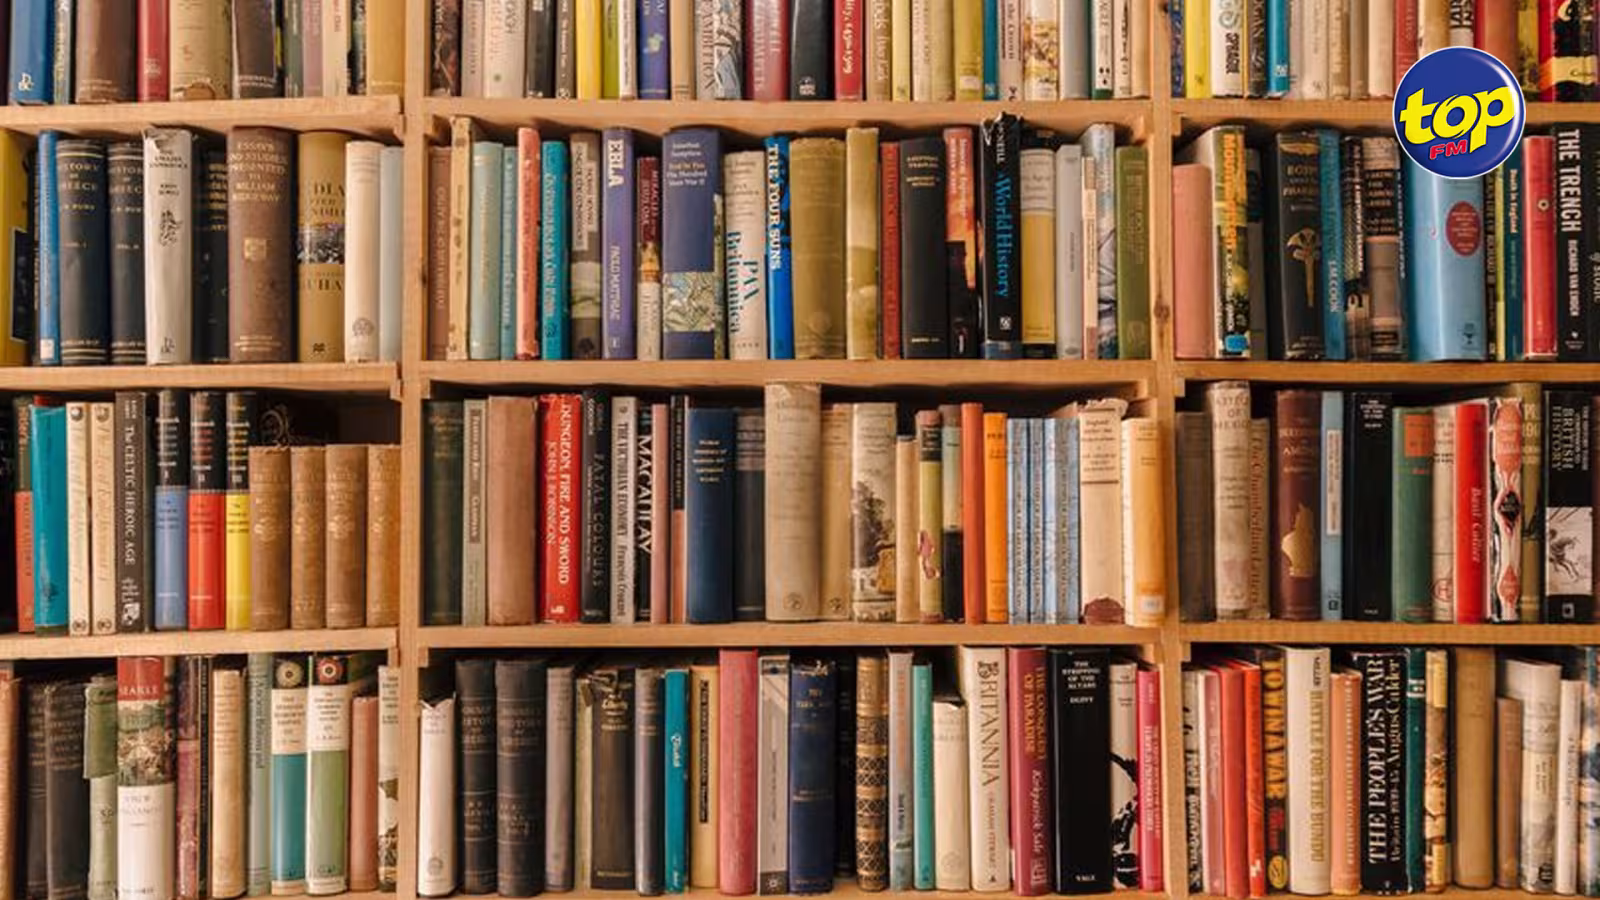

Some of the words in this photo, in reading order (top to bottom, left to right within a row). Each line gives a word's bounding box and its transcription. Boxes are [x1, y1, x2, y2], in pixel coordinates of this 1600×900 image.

[701, 12, 714, 91] AMBITION
[607, 138, 625, 188] EBLA
[767, 143, 781, 179] THE
[1557, 129, 1580, 161] THE
[1509, 168, 1518, 191] Death
[1559, 164, 1581, 232] TRENCH
[767, 182, 782, 226] FOUR
[994, 179, 1014, 232] World
[1508, 202, 1519, 233] England
[769, 228, 782, 271] SUNS
[993, 233, 1014, 298] History
[1566, 239, 1579, 272] RICHARD
[726, 232, 742, 333] Britannica
[742, 260, 760, 301] PAX
[1568, 273, 1580, 289] VAN
[125, 426, 134, 443] The
[558, 404, 572, 470] DUNGEON,
[616, 422, 628, 441] THE
[1550, 406, 1563, 471] HISTORY
[1562, 408, 1576, 469] BRITISH
[124, 444, 135, 487] CELTIC
[546, 441, 556, 473] JOHN
[592, 453, 604, 504] FATAL
[616, 443, 628, 492] VICTORIAN
[558, 474, 572, 503] FIRE
[638, 434, 652, 555] MACAULAY
[124, 490, 135, 537] HEROIC
[546, 484, 557, 545] ROBINSON
[558, 505, 572, 533] AND
[616, 493, 628, 537] ECONOMY
[124, 540, 136, 565] AGE
[559, 537, 572, 584] SWORD
[593, 512, 604, 587] COLOURS
[1023, 673, 1035, 690] OF
[1035, 666, 1047, 688] THE
[1261, 657, 1284, 688] TO
[1366, 659, 1387, 705] WAR
[977, 660, 1001, 787] BRITANNIA
[1023, 693, 1037, 755] PARADISE
[1034, 694, 1048, 761] CONQUEST
[1262, 690, 1285, 732] WIN
[1308, 690, 1324, 745] BATTLE
[1263, 733, 1286, 750] A
[1365, 708, 1388, 808] PEOPLE'S
[1386, 713, 1402, 763] Angus
[1264, 752, 1287, 799] WAR
[1309, 748, 1324, 777] FOR
[1030, 769, 1043, 830] Kirkpatrick
[1310, 778, 1325, 810] THE
[1031, 832, 1044, 854] Sale
[1310, 812, 1325, 863] BUNDU
[1366, 813, 1388, 864] THE
